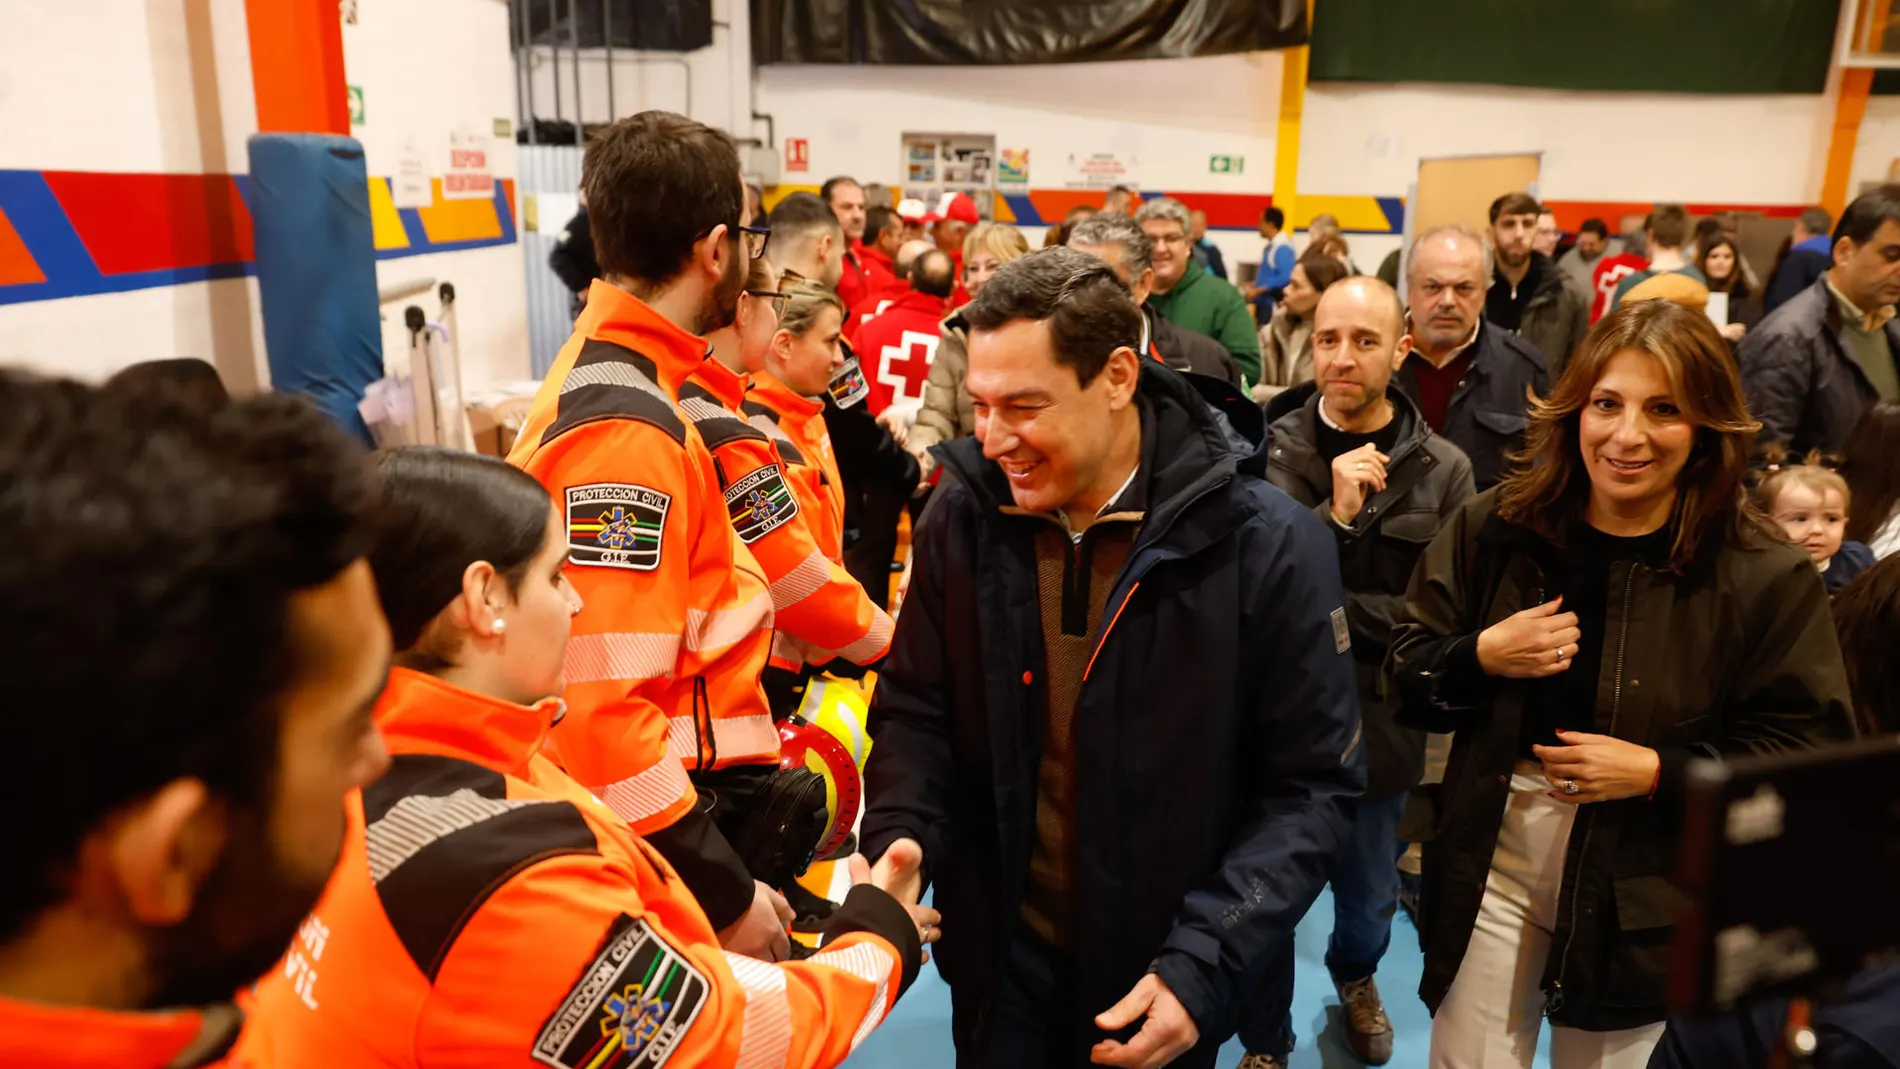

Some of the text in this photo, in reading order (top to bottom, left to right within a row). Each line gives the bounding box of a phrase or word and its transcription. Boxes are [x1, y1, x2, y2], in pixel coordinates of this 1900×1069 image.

[760, 467, 777, 478] CIVIL
[572, 488, 664, 509] PROTECCION CIVIL
[541, 927, 643, 1053] PROTECCION CIVIL
